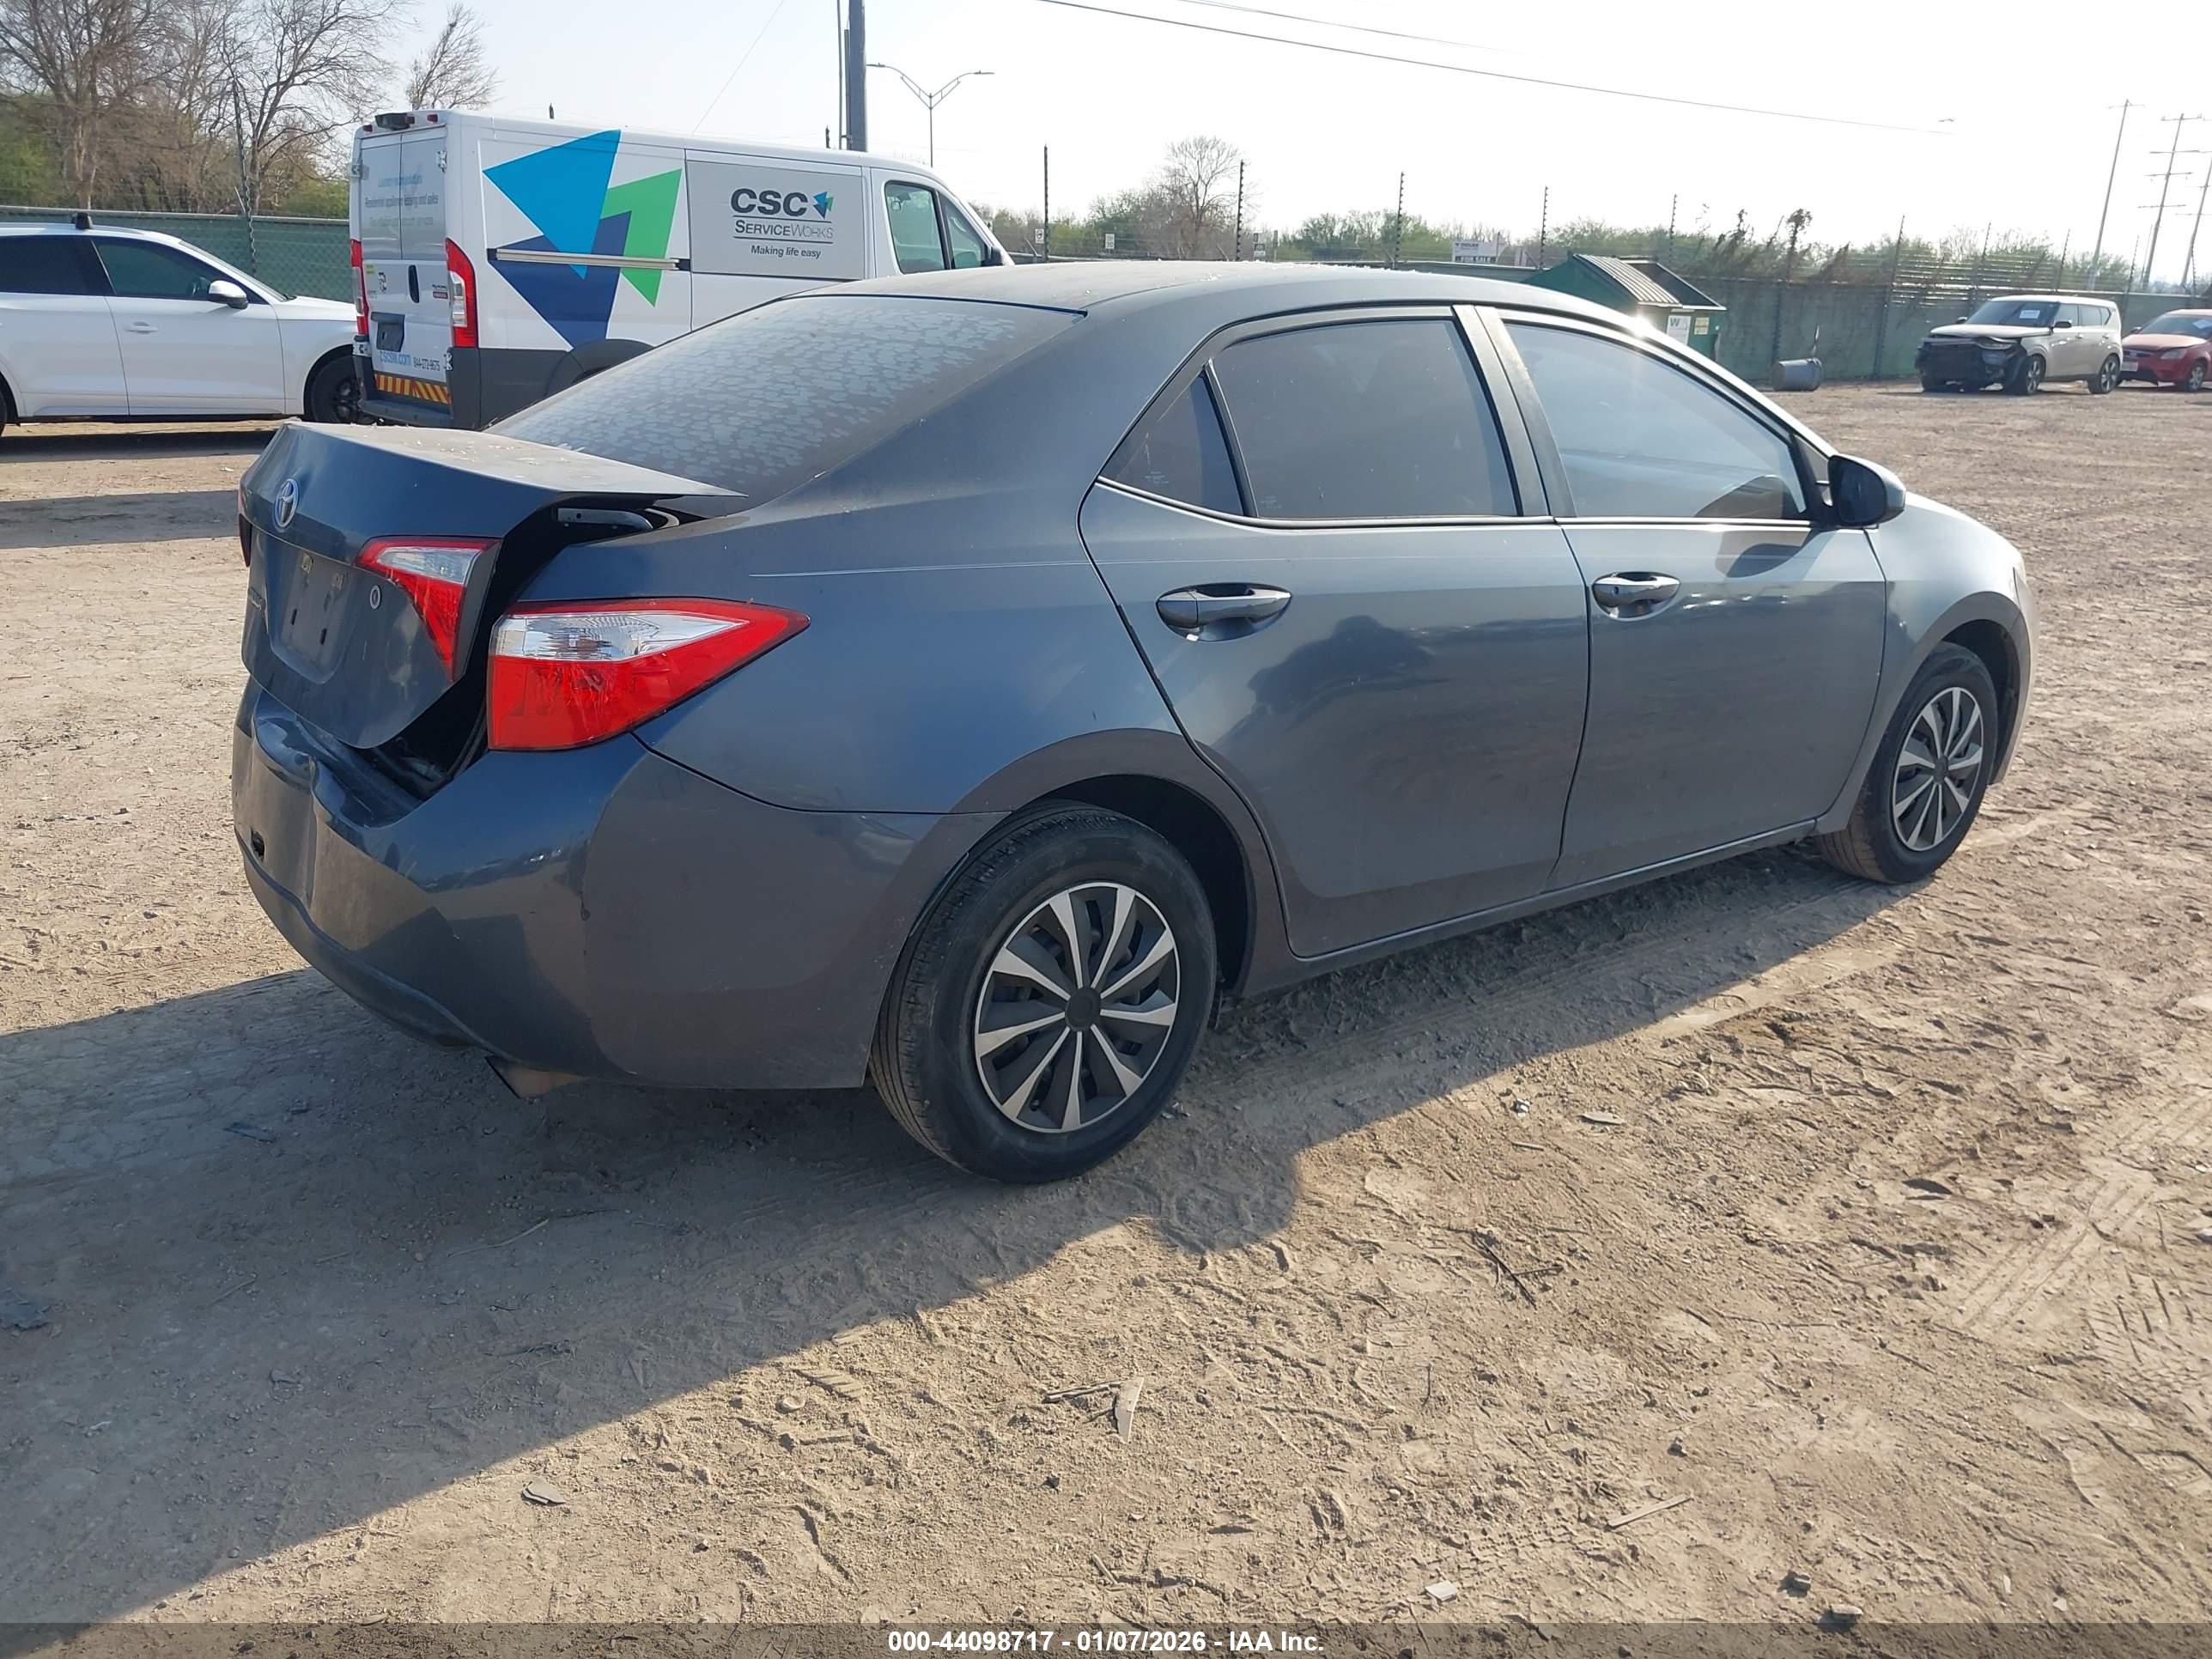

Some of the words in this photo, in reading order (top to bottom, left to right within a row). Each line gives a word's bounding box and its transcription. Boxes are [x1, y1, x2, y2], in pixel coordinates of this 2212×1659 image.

[731, 188, 808, 216] CSC
[750, 245, 784, 258] Making
[786, 246, 799, 257] life
[800, 250, 821, 259] easy
